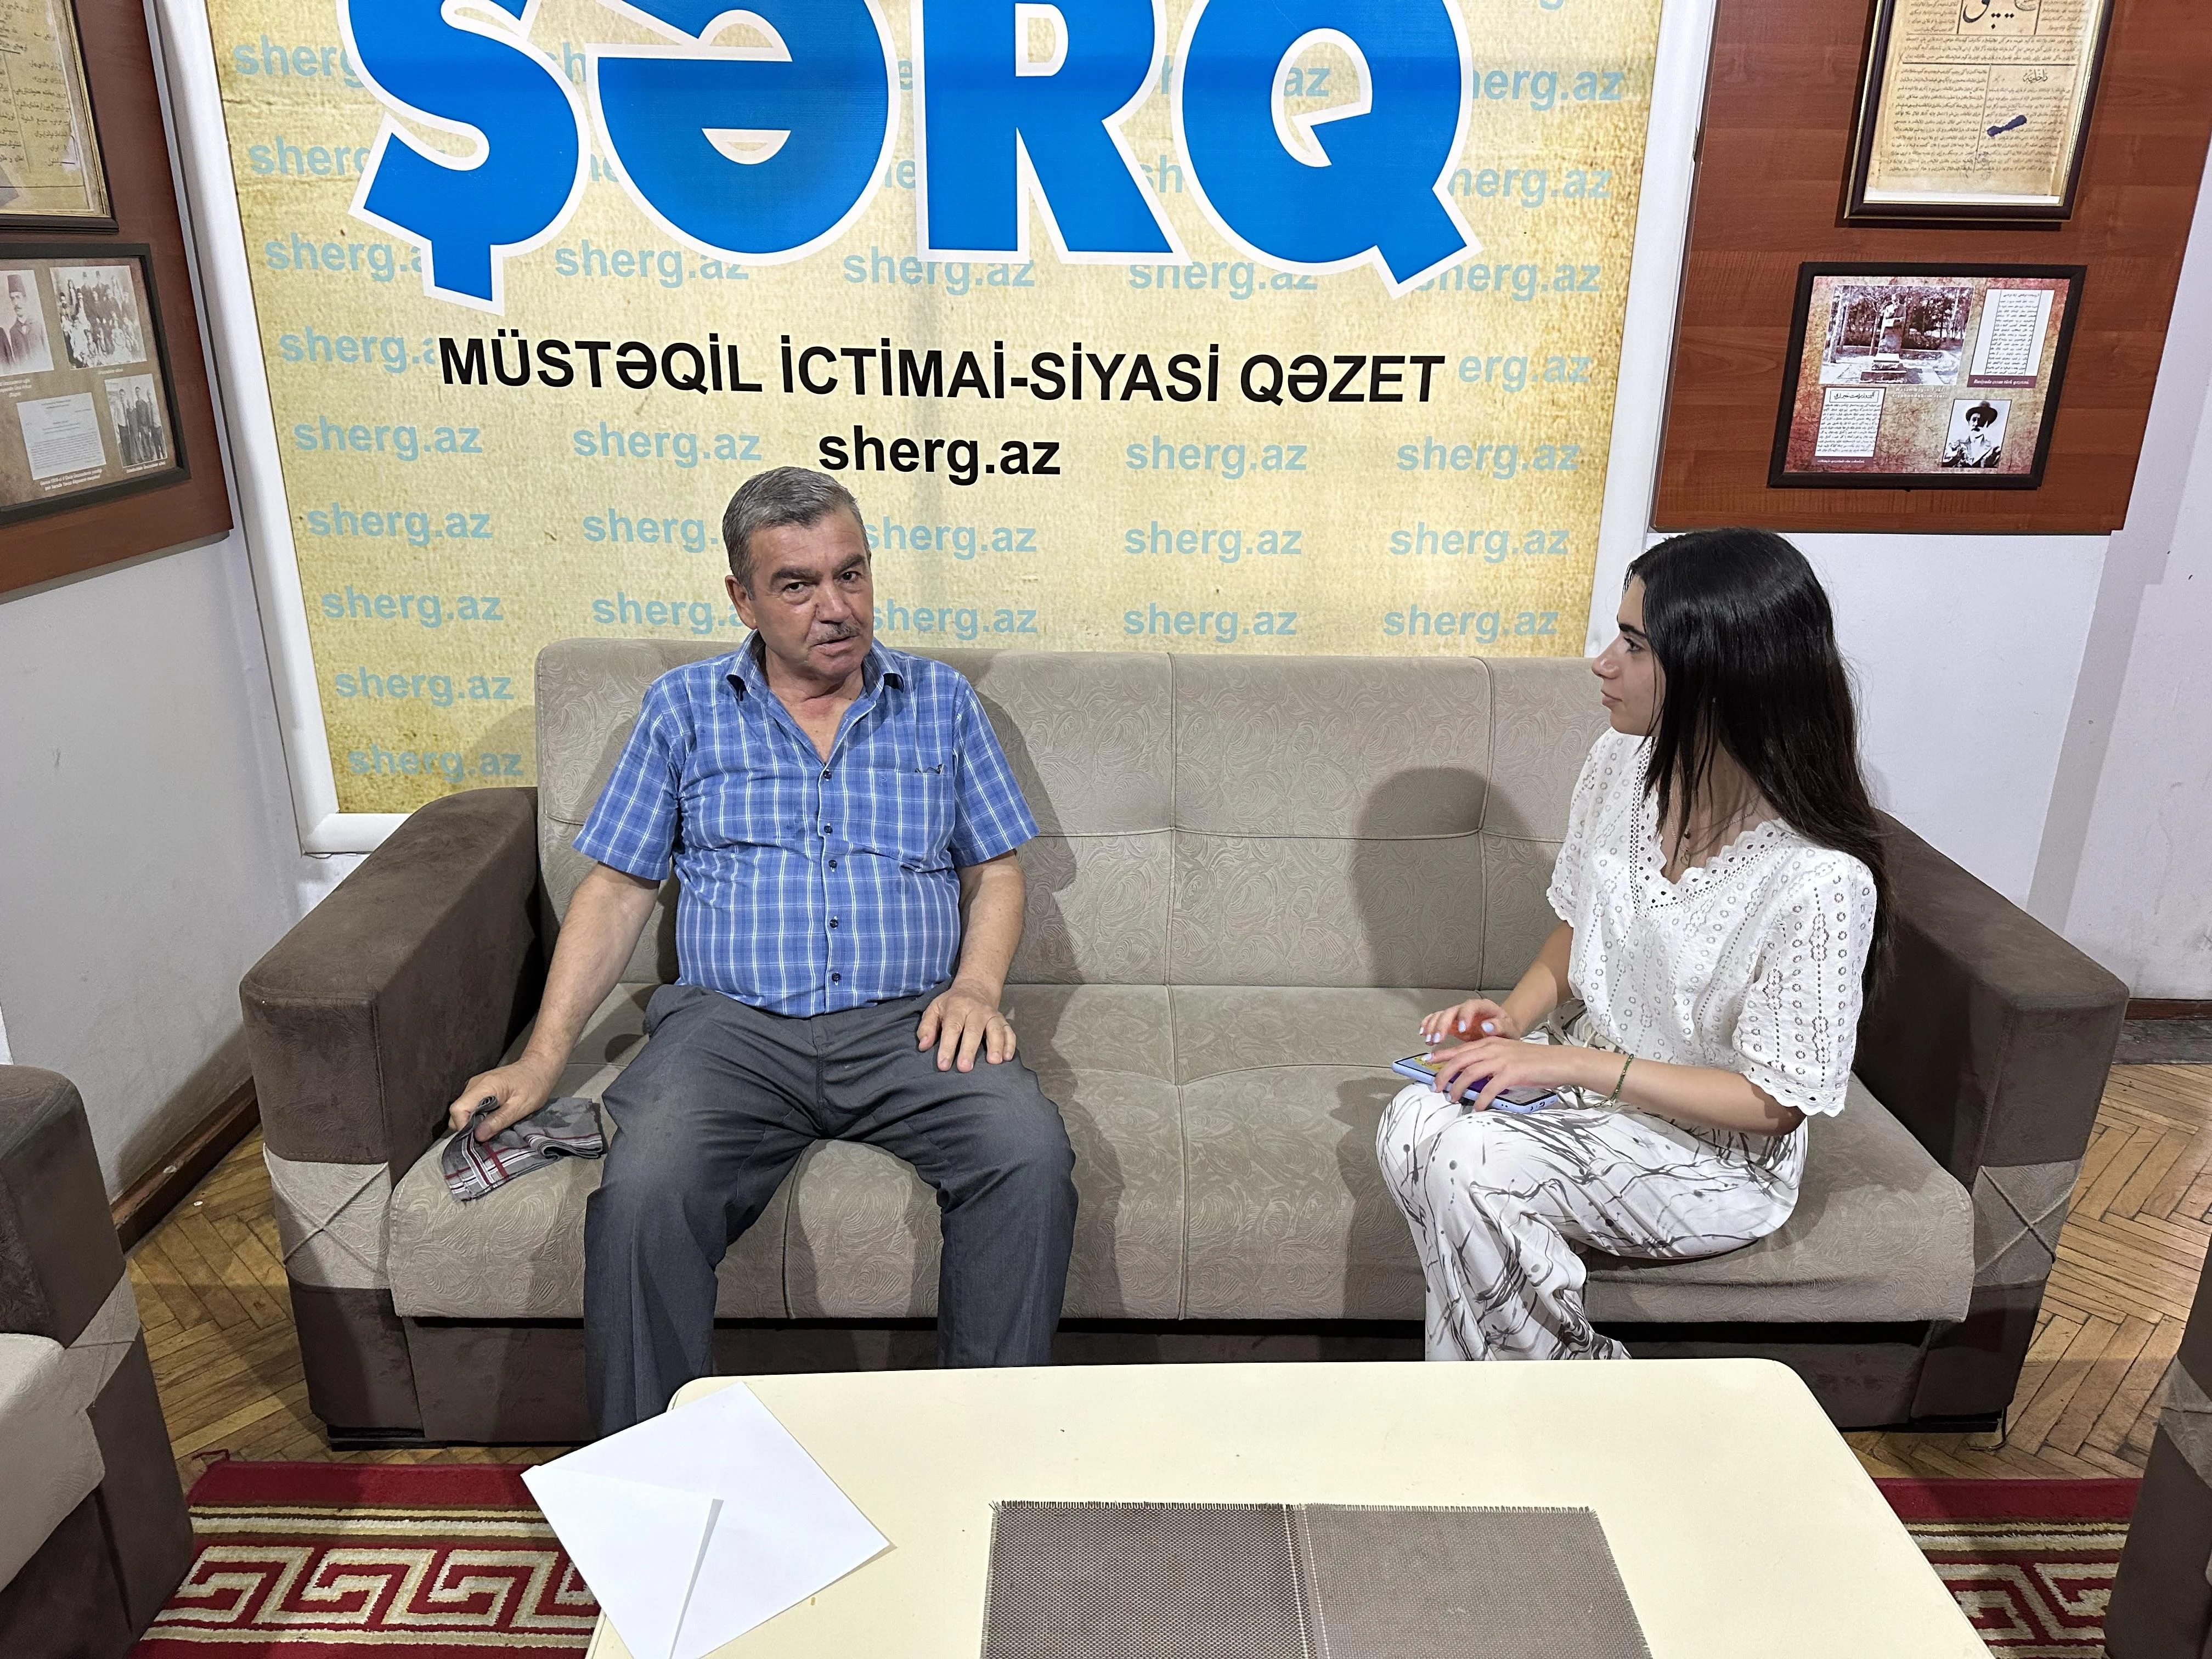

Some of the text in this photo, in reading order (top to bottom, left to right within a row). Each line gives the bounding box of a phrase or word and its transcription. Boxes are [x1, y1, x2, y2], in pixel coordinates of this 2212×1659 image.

[234, 36, 364, 88] sherg
[343, 0, 1476, 308] ŞƏRQ
[556, 240, 749, 288] sherg.az
[843, 246, 1035, 296] sherg.az
[439, 329, 1445, 406] MÜSTƏQİL İCTİMAİ-SİYASİ QƏZET
[294, 416, 483, 461] sherg.az
[573, 422, 761, 468] sherg.az
[819, 425, 1060, 486] sherg.az
[1126, 435, 1307, 479] sherg.az
[1397, 436, 1580, 479] sherg.az
[308, 503, 493, 546] sherg.az
[583, 509, 719, 553] sherg.
[1125, 520, 1302, 563] sherg.az
[1390, 521, 1569, 563] sherg.az
[321, 586, 504, 628] sherg.az
[1124, 602, 1297, 641] sherg.az
[1384, 604, 1559, 644] sherg.az
[335, 667, 514, 707] sherg.az
[348, 743, 525, 783] sherg.az
